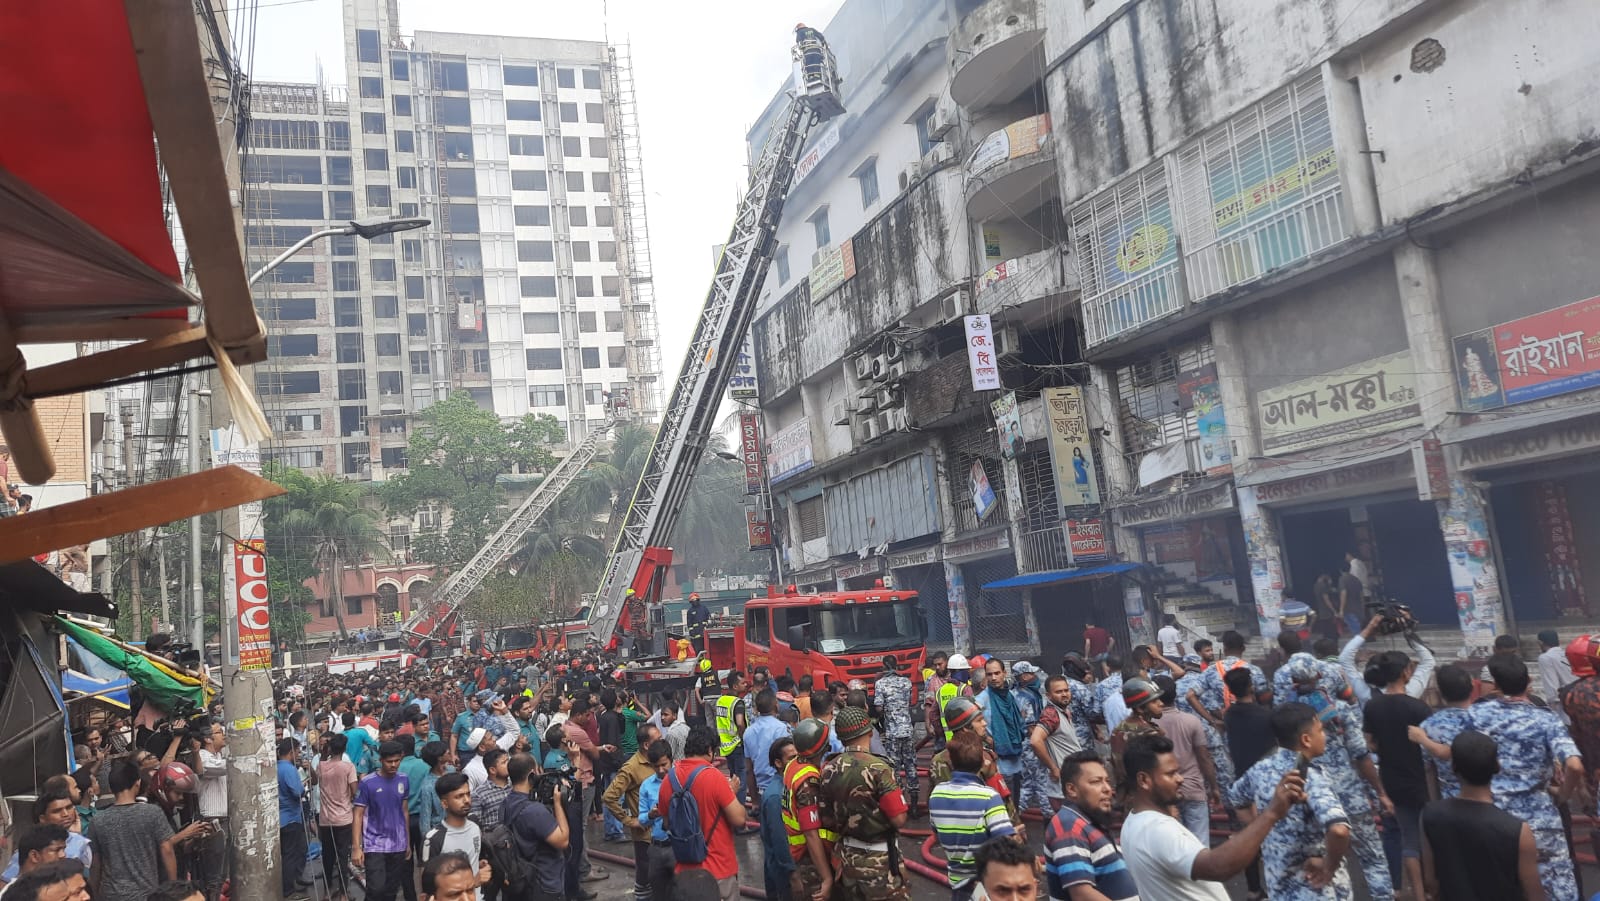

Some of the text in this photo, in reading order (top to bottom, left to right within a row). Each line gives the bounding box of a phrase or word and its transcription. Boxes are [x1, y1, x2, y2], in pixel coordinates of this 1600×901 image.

[1252, 177, 1288, 204] STAR
[1501, 331, 1585, 377] রাইয়ান
[1050, 396, 1081, 415] আল
[1054, 416, 1085, 436] মক্কা
[1460, 434, 1548, 466] ANNEXCO
[1122, 501, 1169, 524] ANNEXCO
